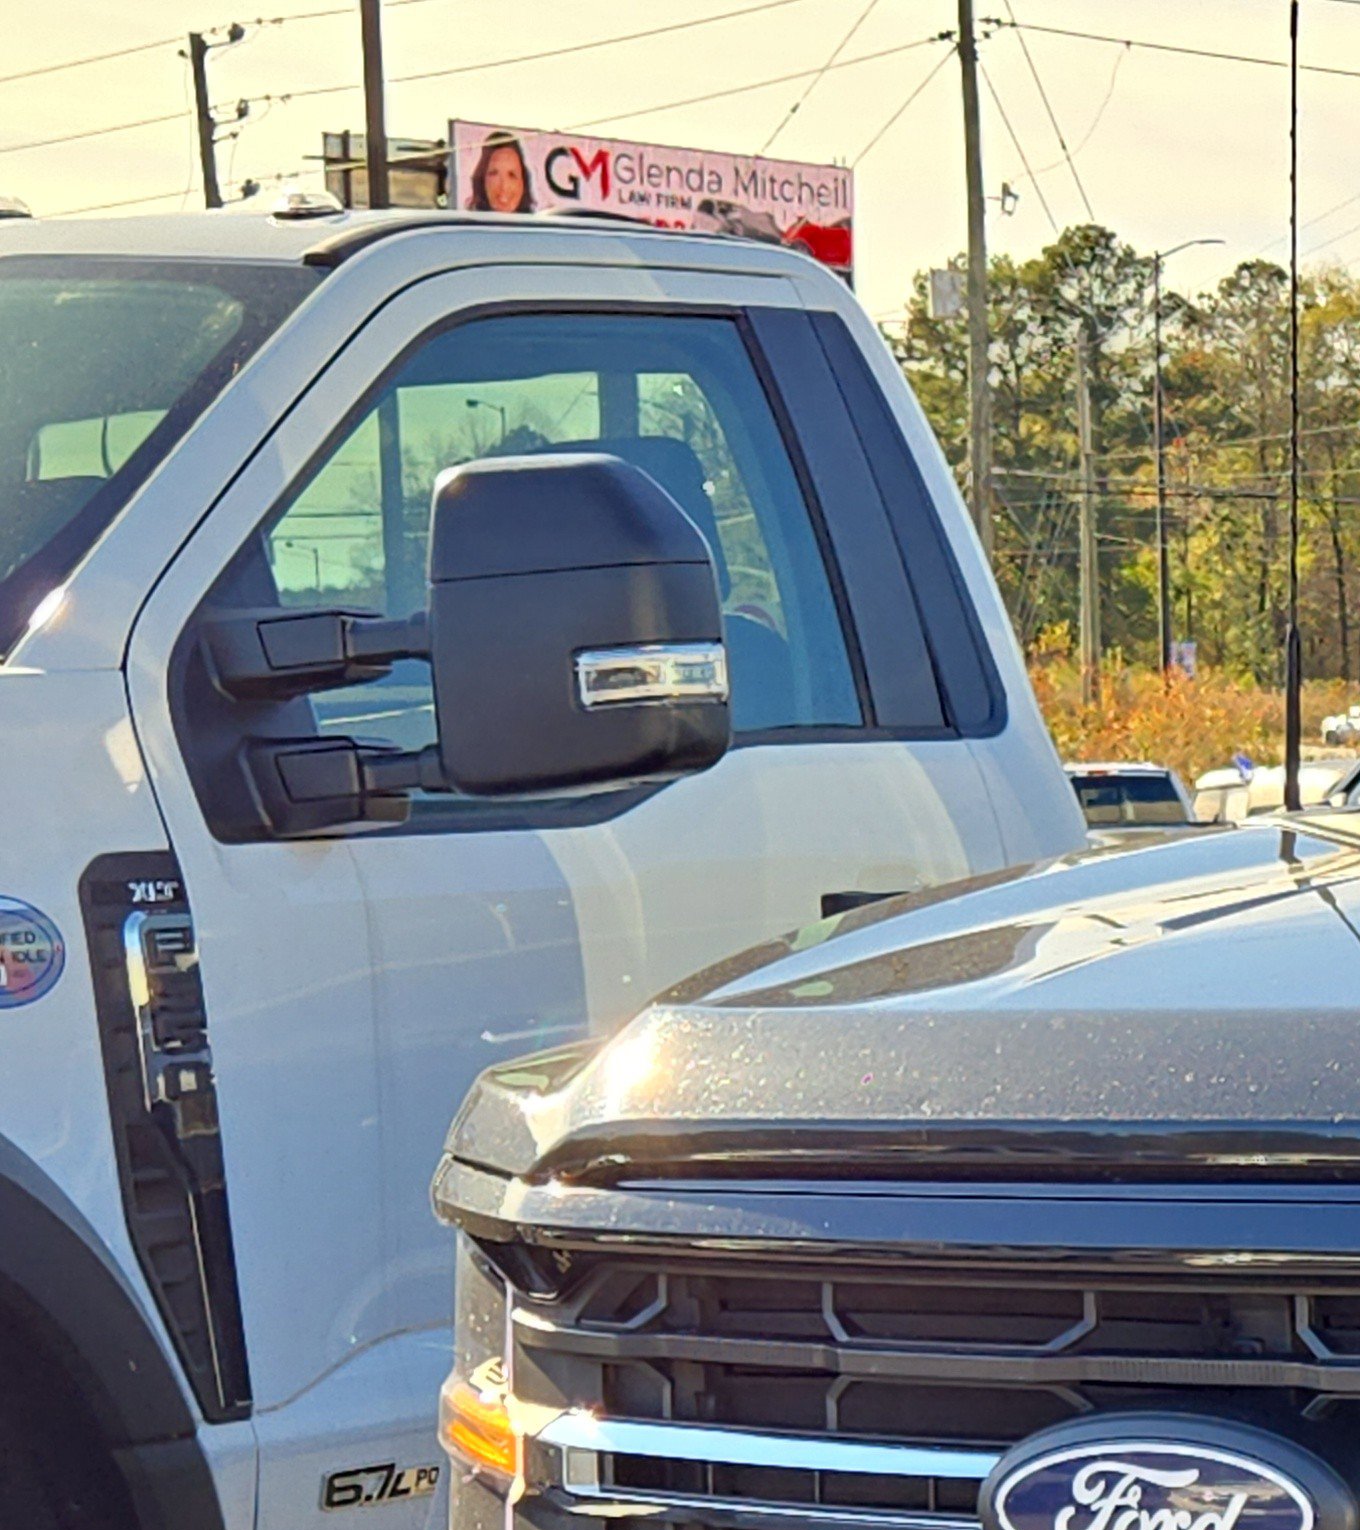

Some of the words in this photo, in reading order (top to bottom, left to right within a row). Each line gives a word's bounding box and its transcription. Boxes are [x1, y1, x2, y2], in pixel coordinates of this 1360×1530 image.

[545, 146, 611, 201] GM
[613, 152, 723, 193] Glenda
[733, 165, 848, 210] Mitchell
[618, 188, 651, 206] LAW
[656, 192, 693, 210] FIRM
[325, 1462, 412, 1508] 6.7L
